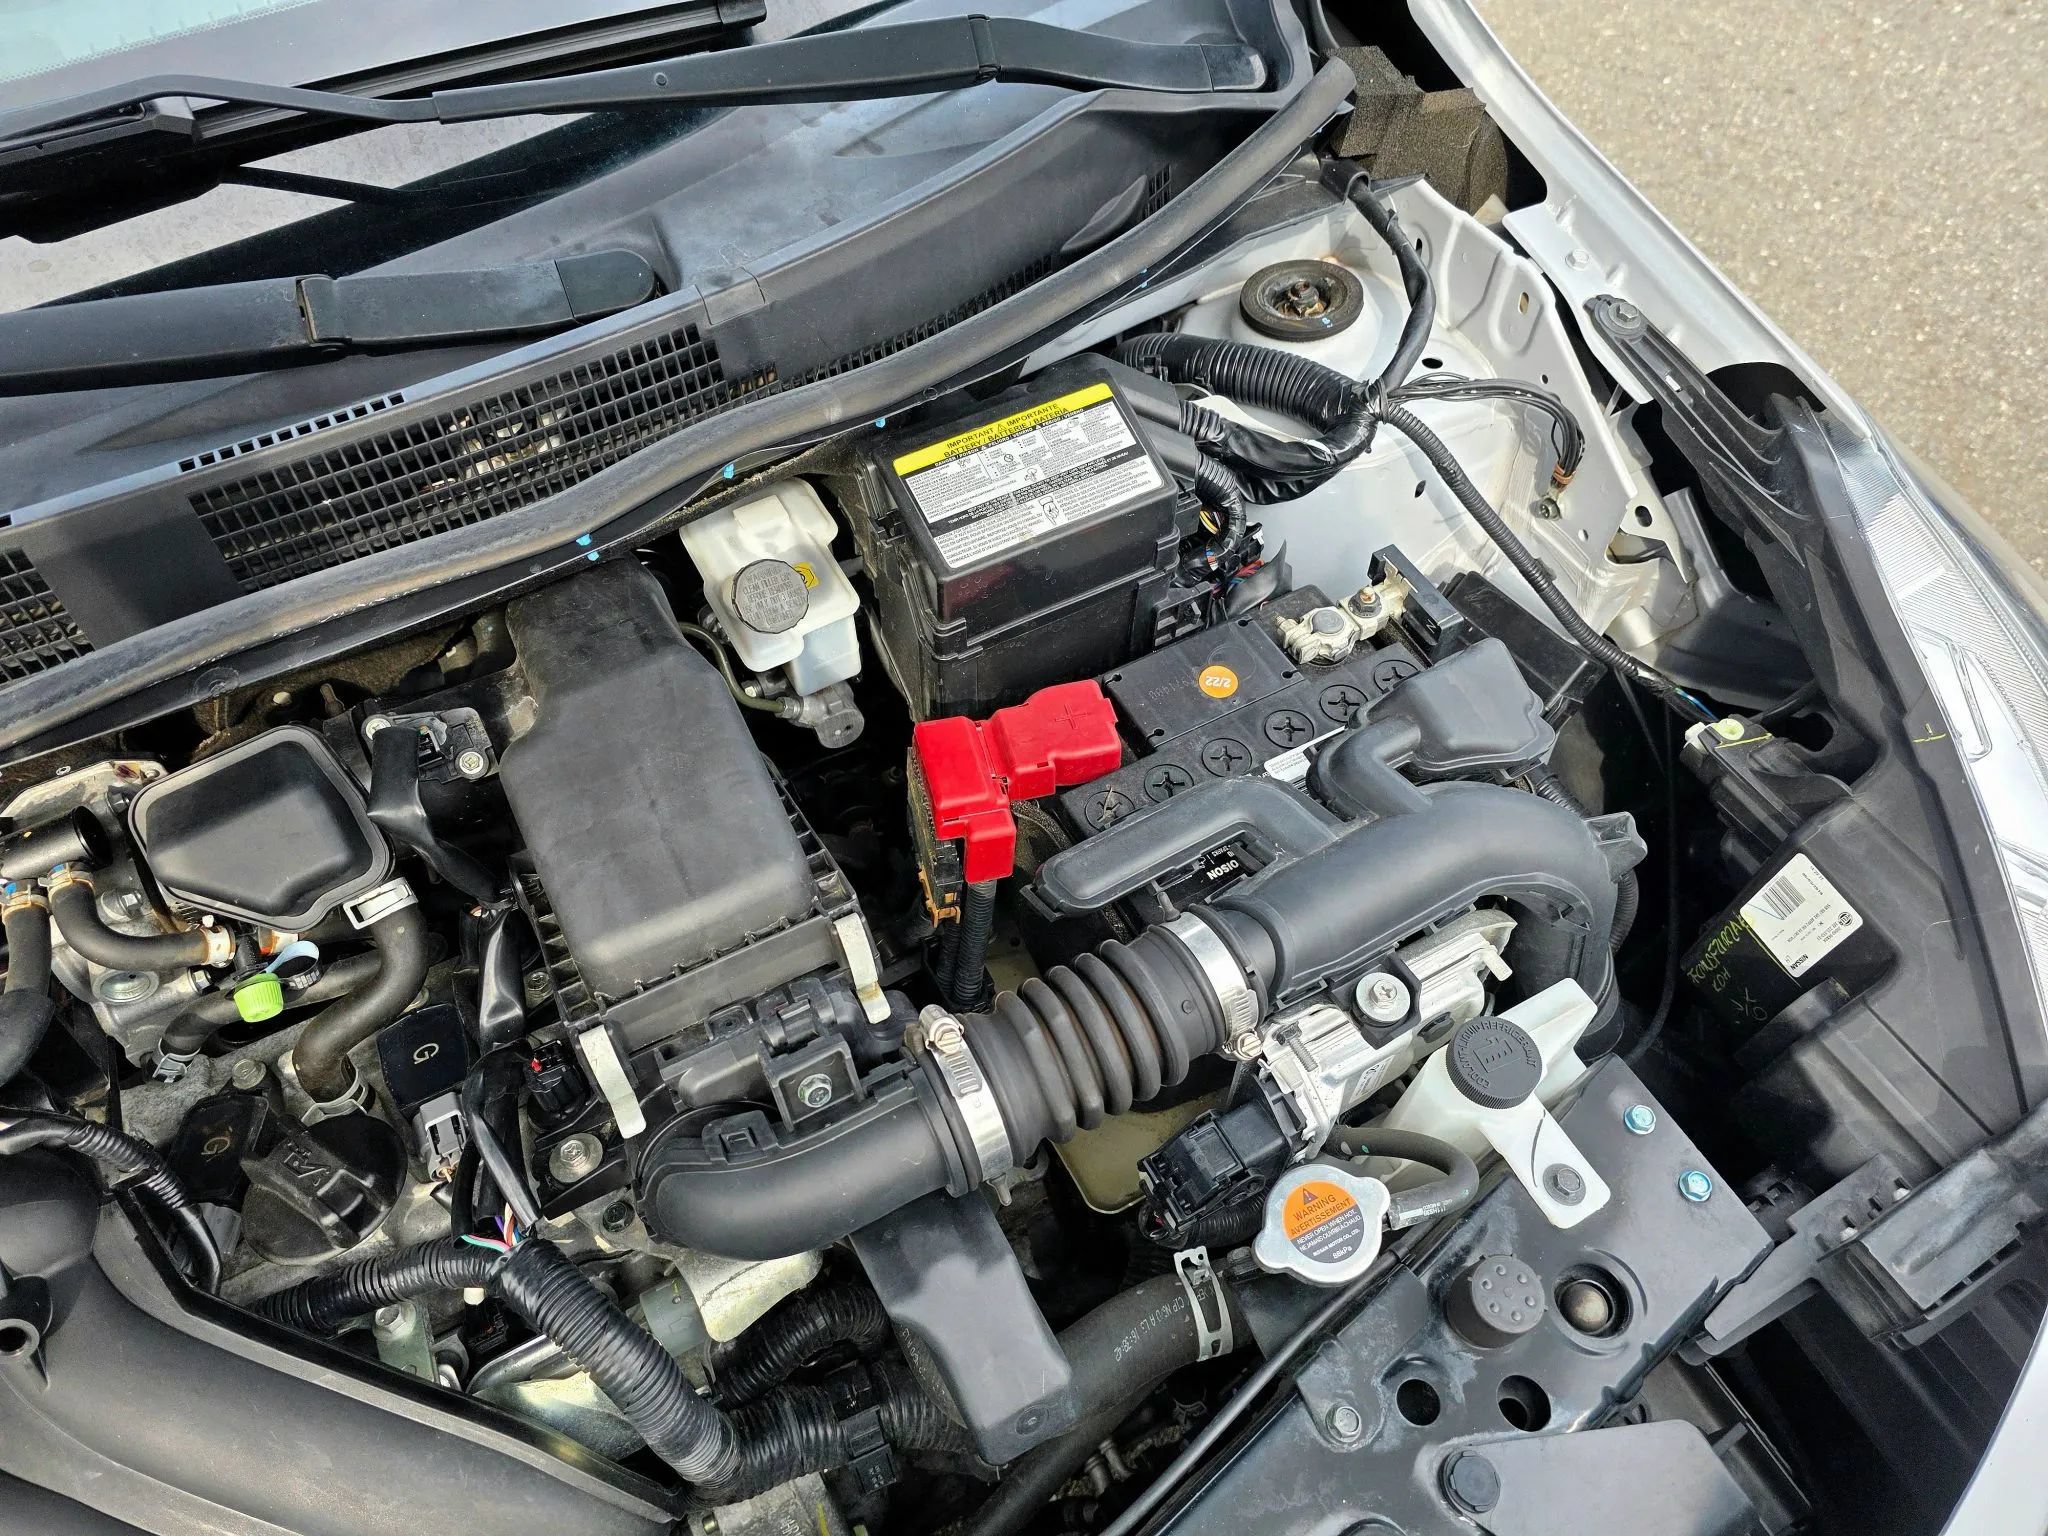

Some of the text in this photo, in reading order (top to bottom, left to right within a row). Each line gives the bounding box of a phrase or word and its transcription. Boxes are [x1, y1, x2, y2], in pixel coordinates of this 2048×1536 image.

[947, 403, 1058, 448] IMPORTANT IMPORTANTE
[944, 440, 982, 456] BATTERY
[988, 423, 1027, 440] BATTERIE
[1205, 675, 1231, 687] 2/22
[1205, 859, 1239, 879] OISON
[1789, 953, 1808, 970] NISSAN
[1291, 1198, 1351, 1235] AVERTISSEMENT
[1294, 1194, 1335, 1220] WARNING
[1296, 1232, 1314, 1244] NEVER
[1313, 1223, 1329, 1235] OPEN
[1328, 1215, 1345, 1227] WHEN
[1312, 1245, 1328, 1256] NISSAN
[1328, 1237, 1343, 1248] MOTOR
[1331, 1245, 1352, 1258] 88kPa
